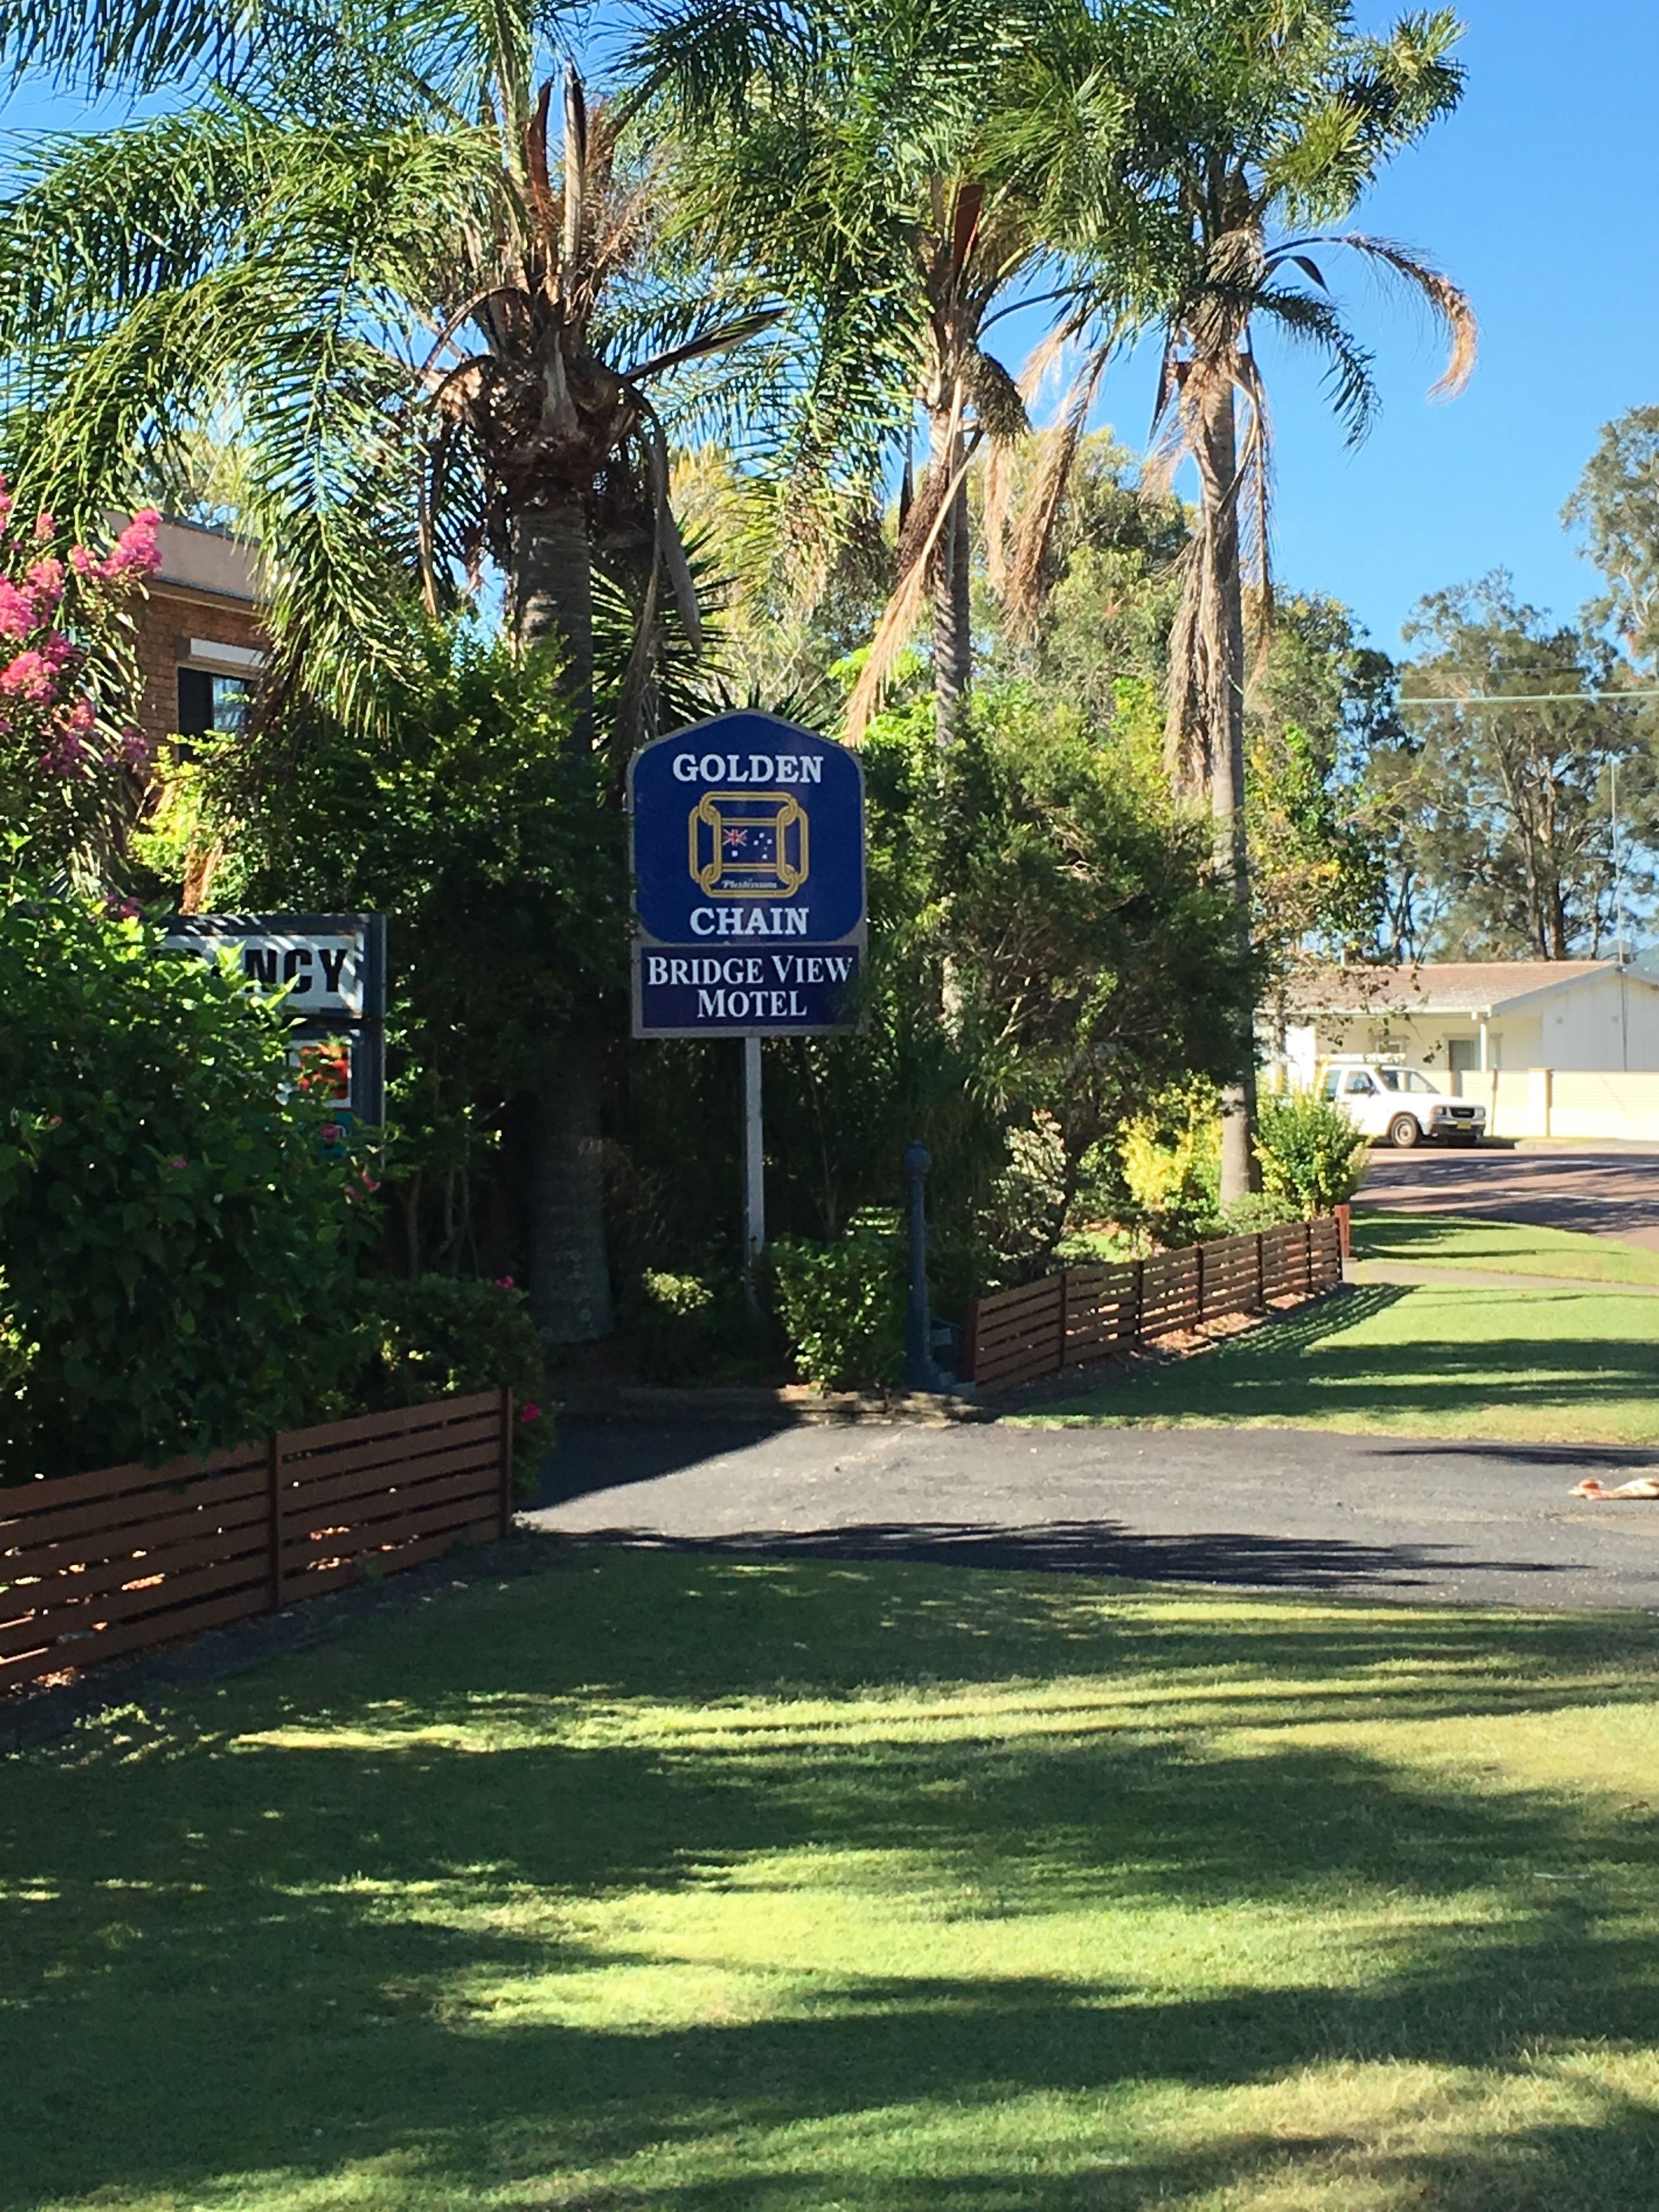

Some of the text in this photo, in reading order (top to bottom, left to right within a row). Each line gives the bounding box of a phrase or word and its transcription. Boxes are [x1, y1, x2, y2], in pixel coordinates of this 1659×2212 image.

[672, 754, 824, 783] GOLDEN
[690, 907, 809, 935] CHAIN
[647, 955, 853, 986] BRIDGE VIEW
[697, 989, 807, 1018] MOTEL
